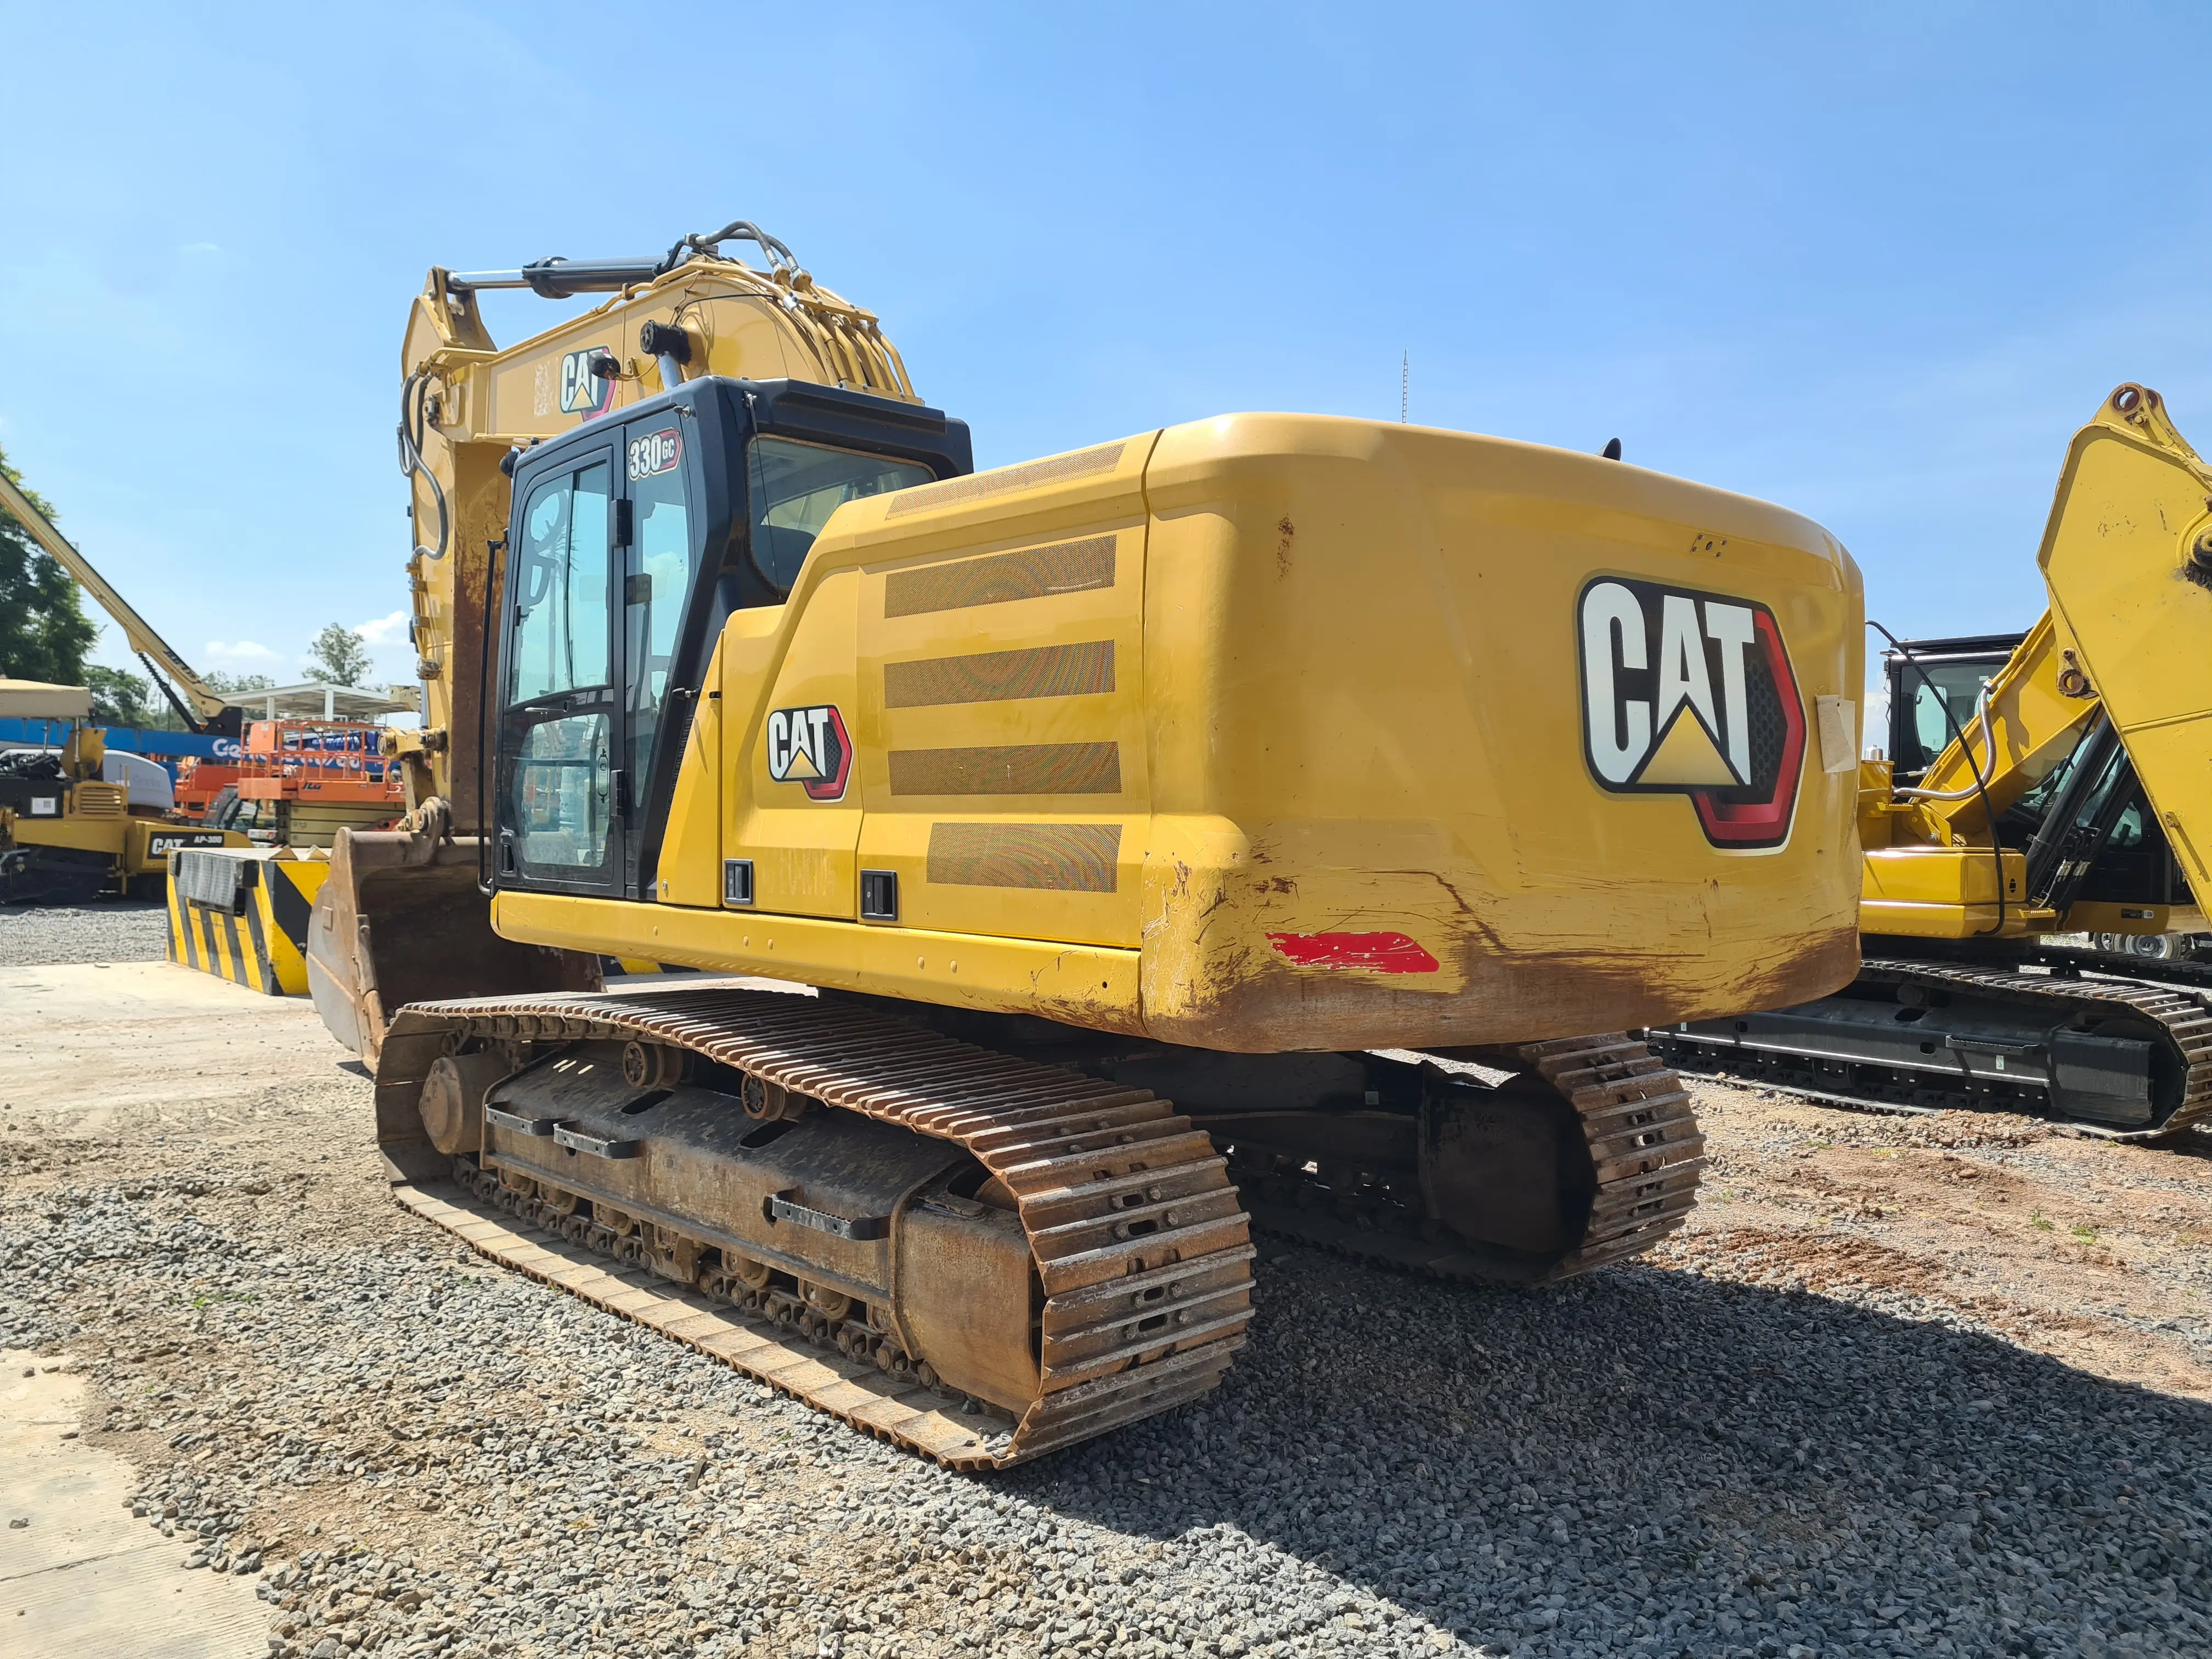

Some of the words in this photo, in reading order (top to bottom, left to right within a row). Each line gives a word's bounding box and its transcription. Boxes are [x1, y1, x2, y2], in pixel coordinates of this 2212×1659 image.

[561, 348, 603, 411] CAT
[1582, 582, 1756, 786] CAT
[768, 708, 828, 780] CAT
